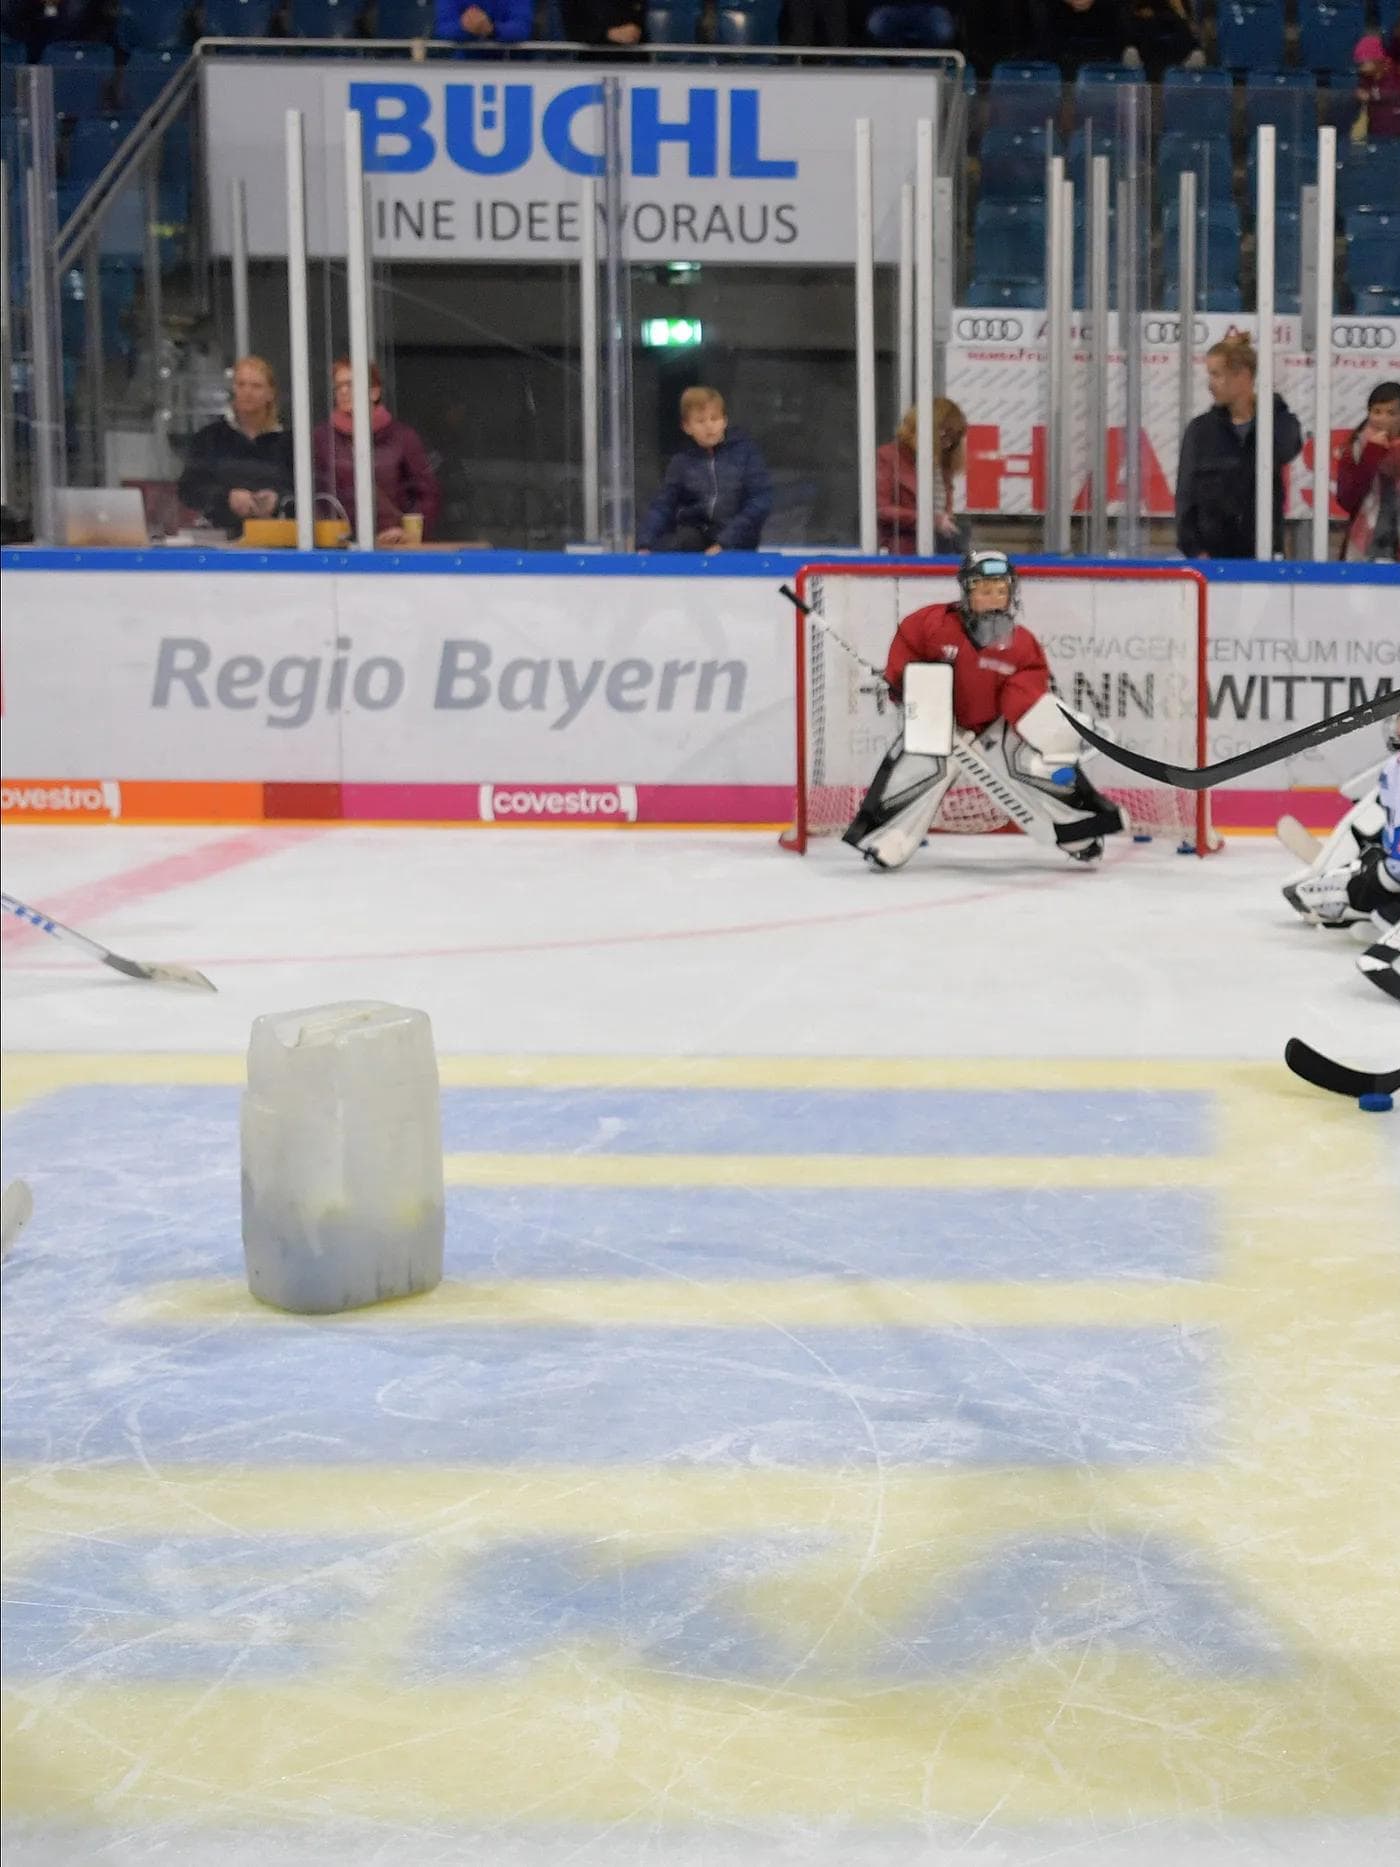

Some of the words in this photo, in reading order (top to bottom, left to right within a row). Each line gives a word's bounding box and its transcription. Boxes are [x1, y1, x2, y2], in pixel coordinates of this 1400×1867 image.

[349, 82, 798, 179] BÜCHL
[377, 199, 455, 239] INE
[475, 200, 581, 242] IDEE
[150, 635, 406, 730] Regio
[433, 638, 749, 730] Bayern
[1207, 674, 1394, 721] WITTM
[2, 785, 103, 811] ovestro
[493, 788, 621, 815] covestro
